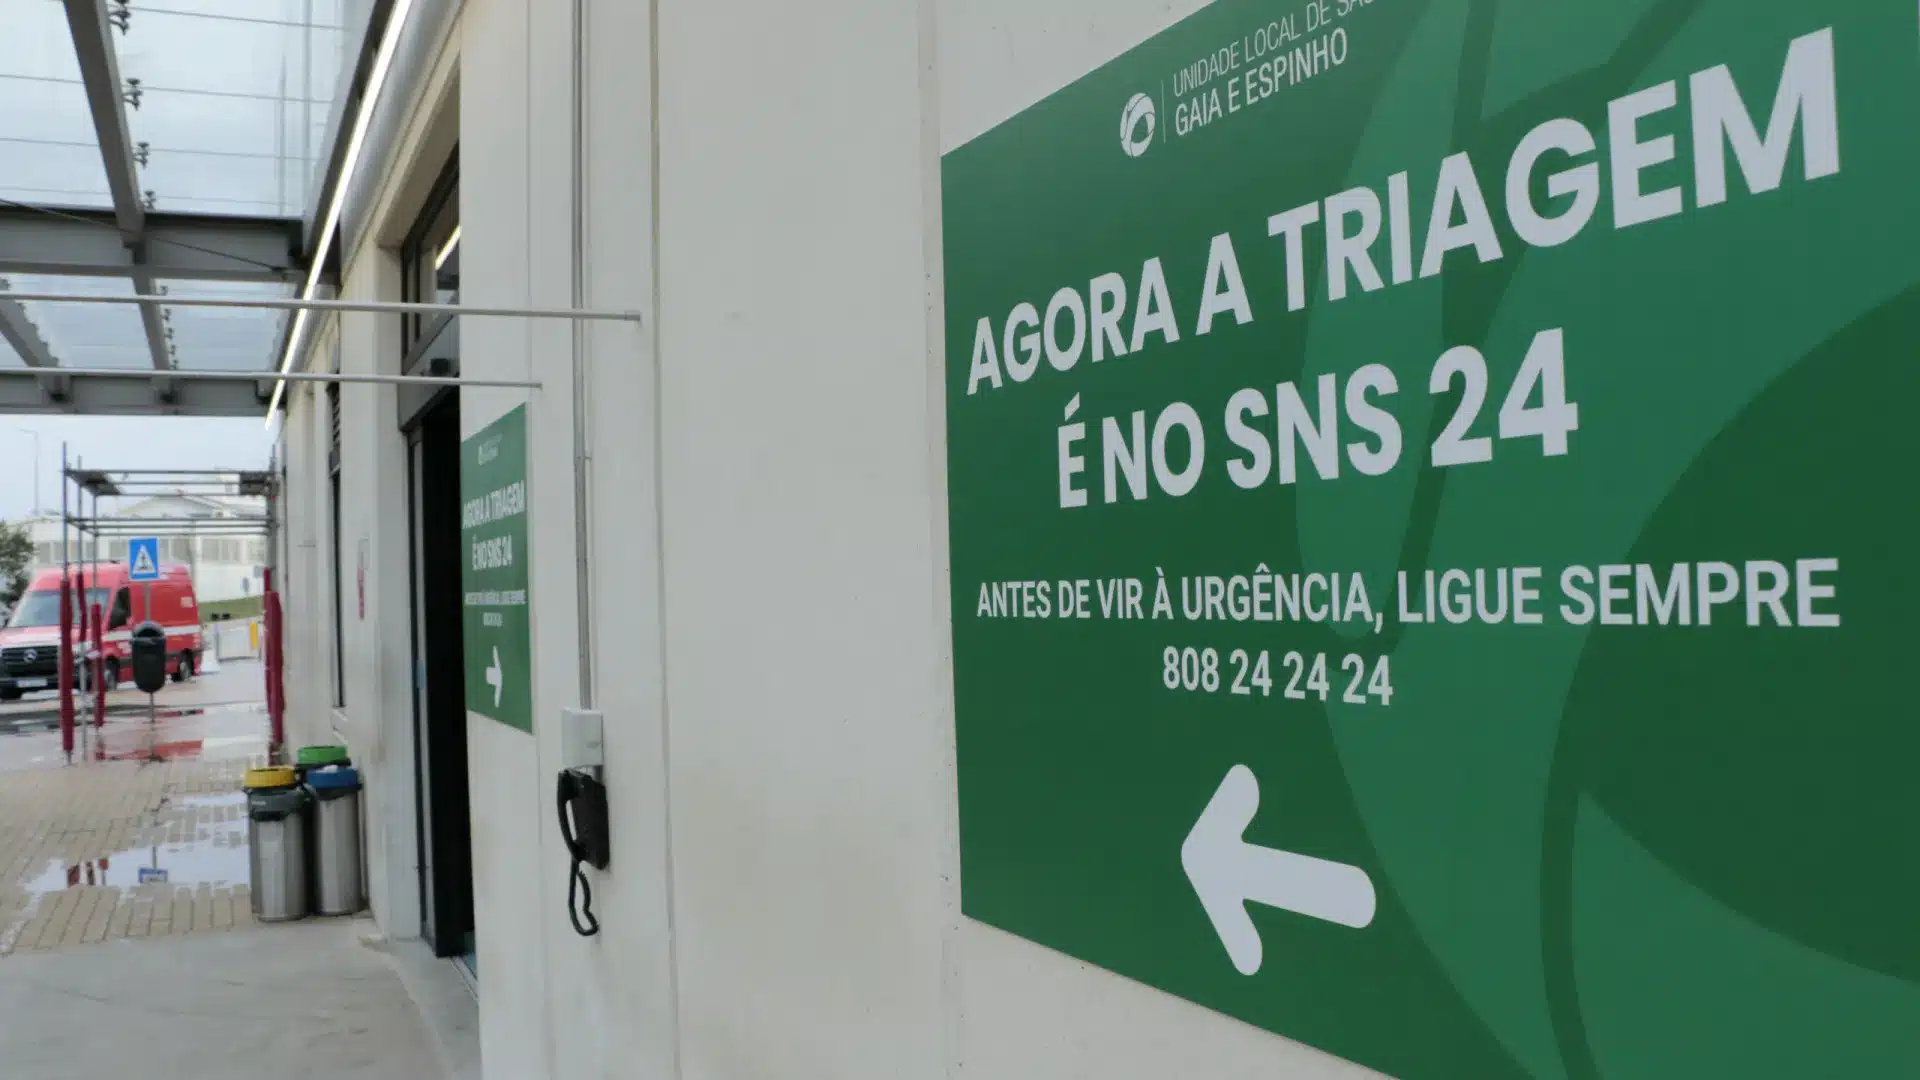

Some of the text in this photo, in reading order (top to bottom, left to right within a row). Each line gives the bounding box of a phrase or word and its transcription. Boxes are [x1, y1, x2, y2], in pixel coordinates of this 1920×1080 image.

[1173, 0, 1332, 98] UNIDADE LOCAL DE
[1175, 27, 1349, 137] GAIA E ESPINHO
[967, 27, 1840, 395] AGORA A TRIAGEM
[1058, 328, 1579, 508] É NO SNS 24
[977, 558, 1840, 633] ANTES DE VIR À URGÊNCIA, LIGUE SEMPRE
[1163, 646, 1394, 706] 808 24 24 24
